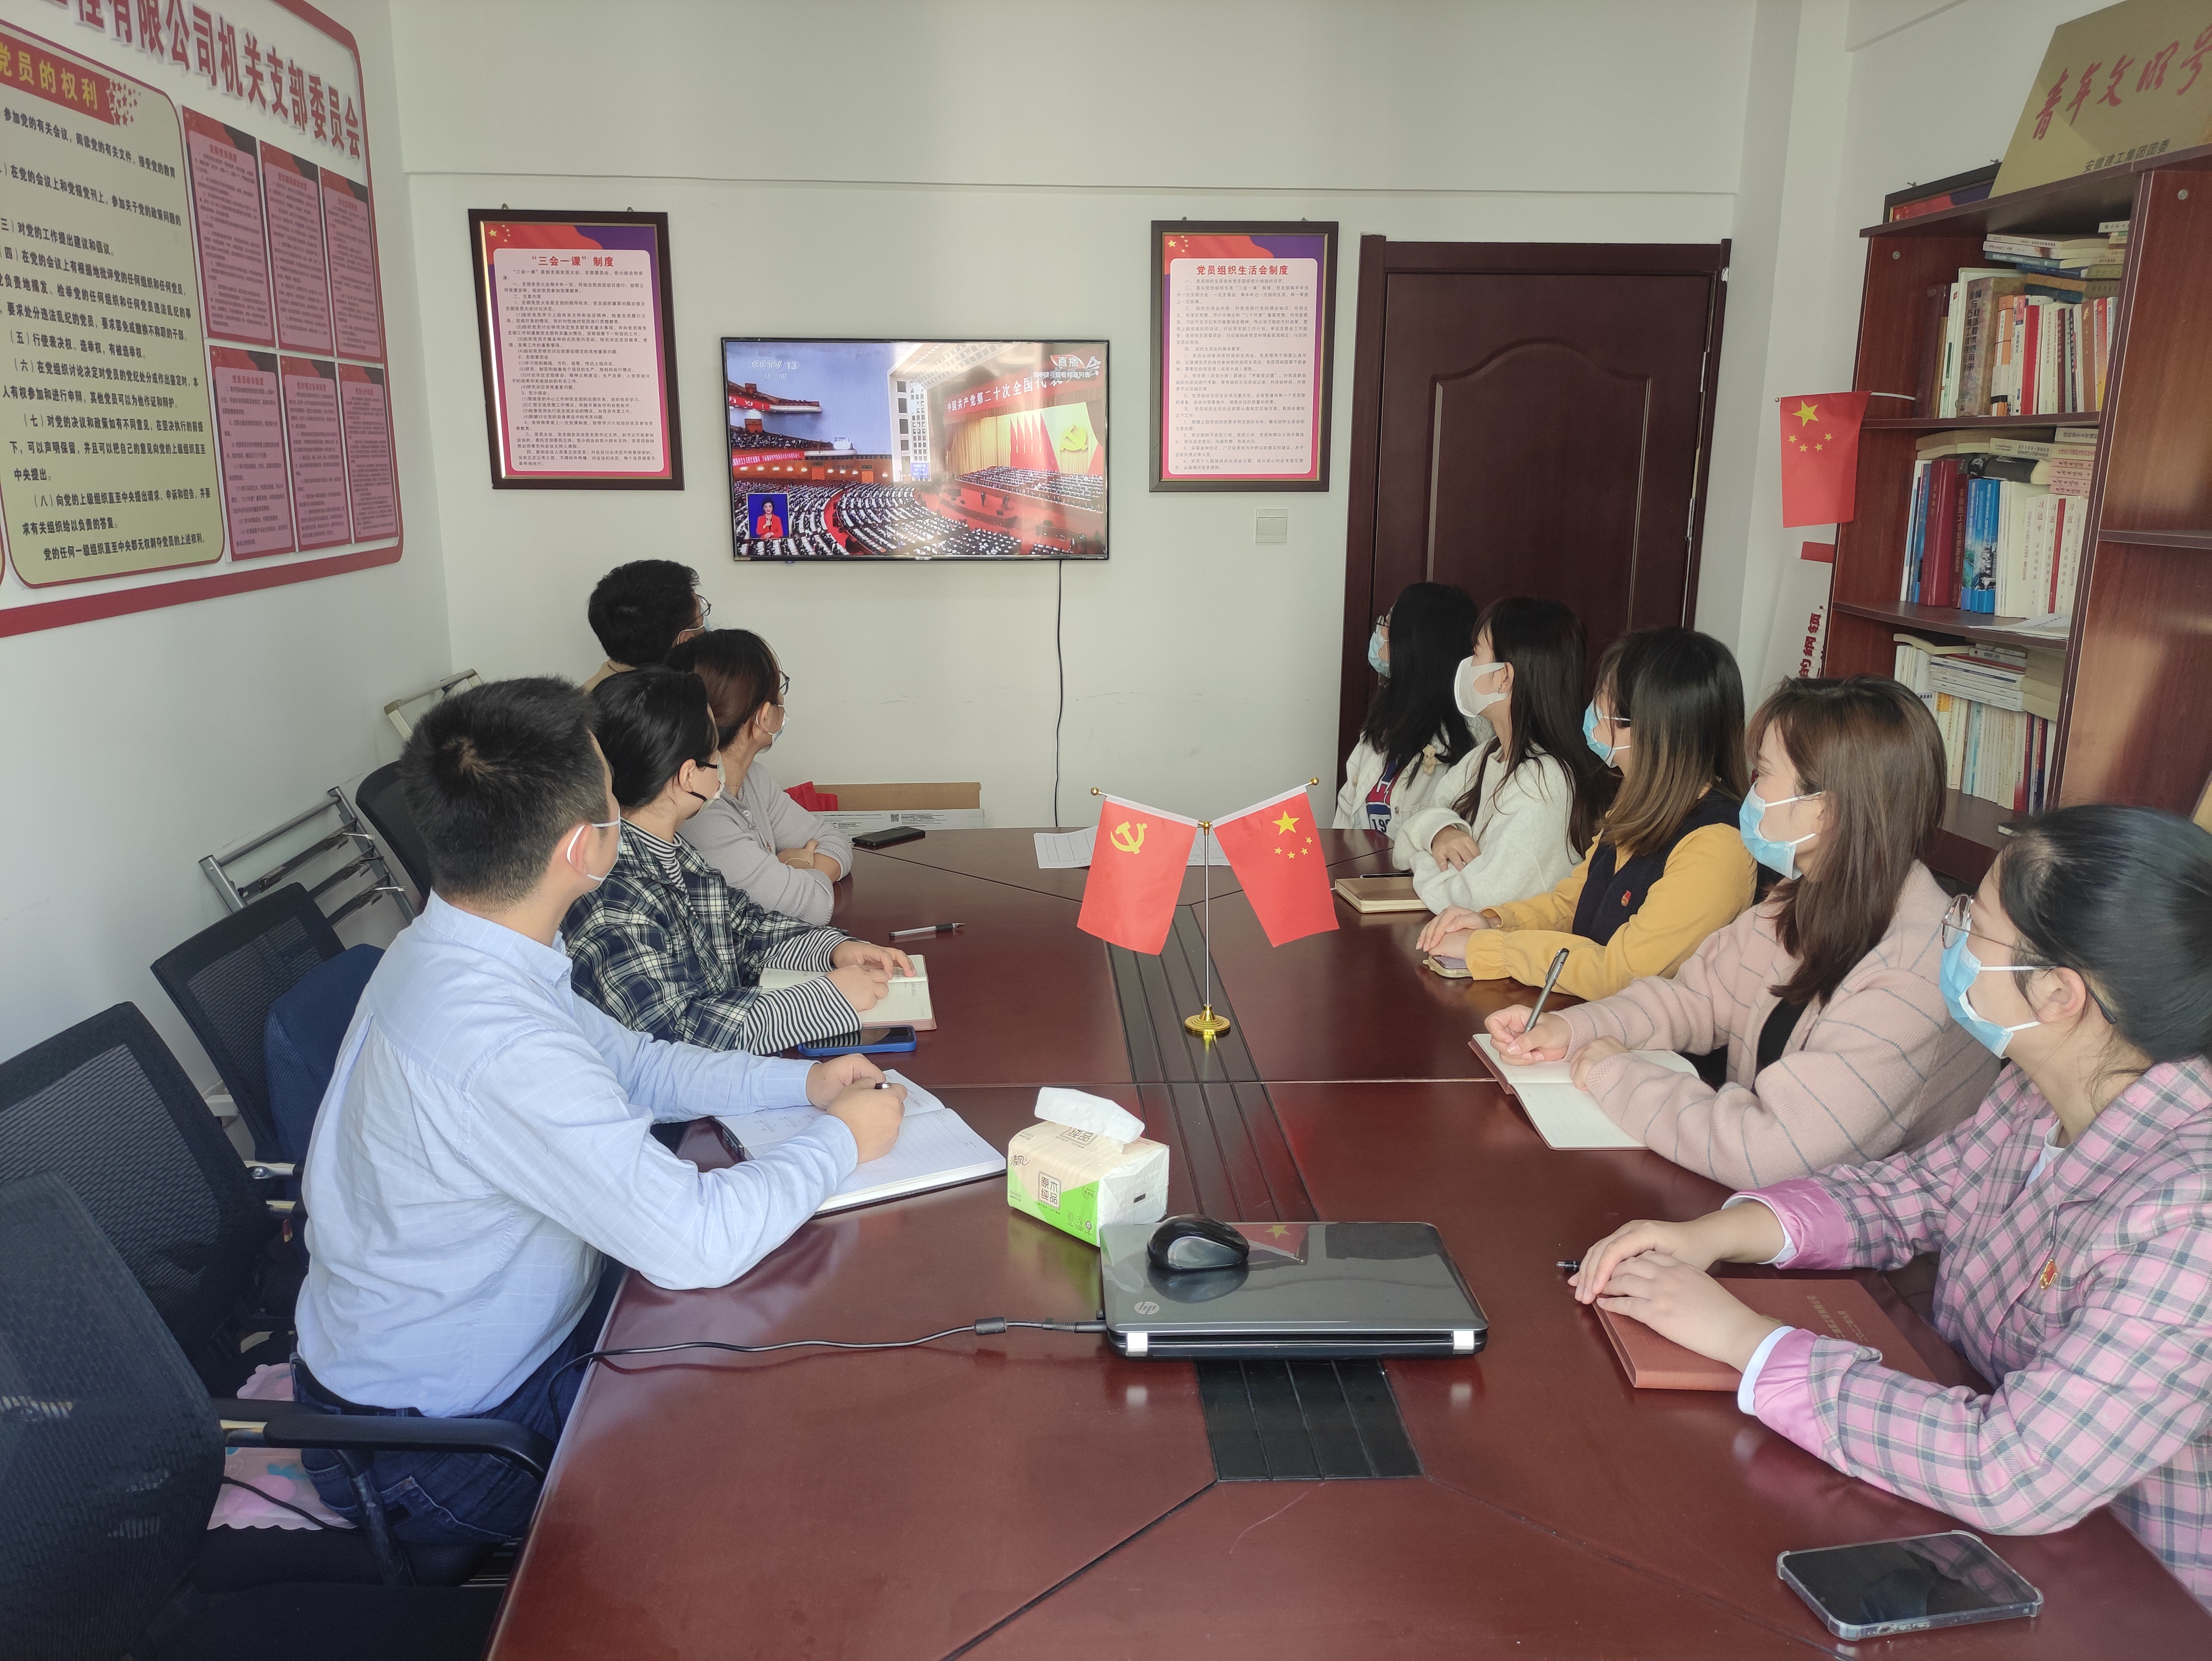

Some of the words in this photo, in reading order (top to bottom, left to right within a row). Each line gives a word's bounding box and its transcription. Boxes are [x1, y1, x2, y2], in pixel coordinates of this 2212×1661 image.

[48, 0, 360, 160] 有限公司机关支部委员会
[0, 162, 181, 226] ）在党的会议上和党报党刊上，参加关于党的政策问题的
[531, 255, 614, 267] “三会一课”制度
[1196, 265, 1288, 276] 党员组织生活会制度
[752, 360, 783, 369] CCTV
[786, 361, 797, 370] 13
[1057, 356, 1079, 367] 直播
[14, 468, 51, 481] 中央提出。
[22, 517, 117, 536] 求有关组织给以负责的答复。
[2066, 503, 2075, 536] 习近平
[1010, 1154, 1030, 1167] 清风
[1041, 1176, 1058, 1193] 原木
[1040, 1188, 1058, 1205] 纯品
